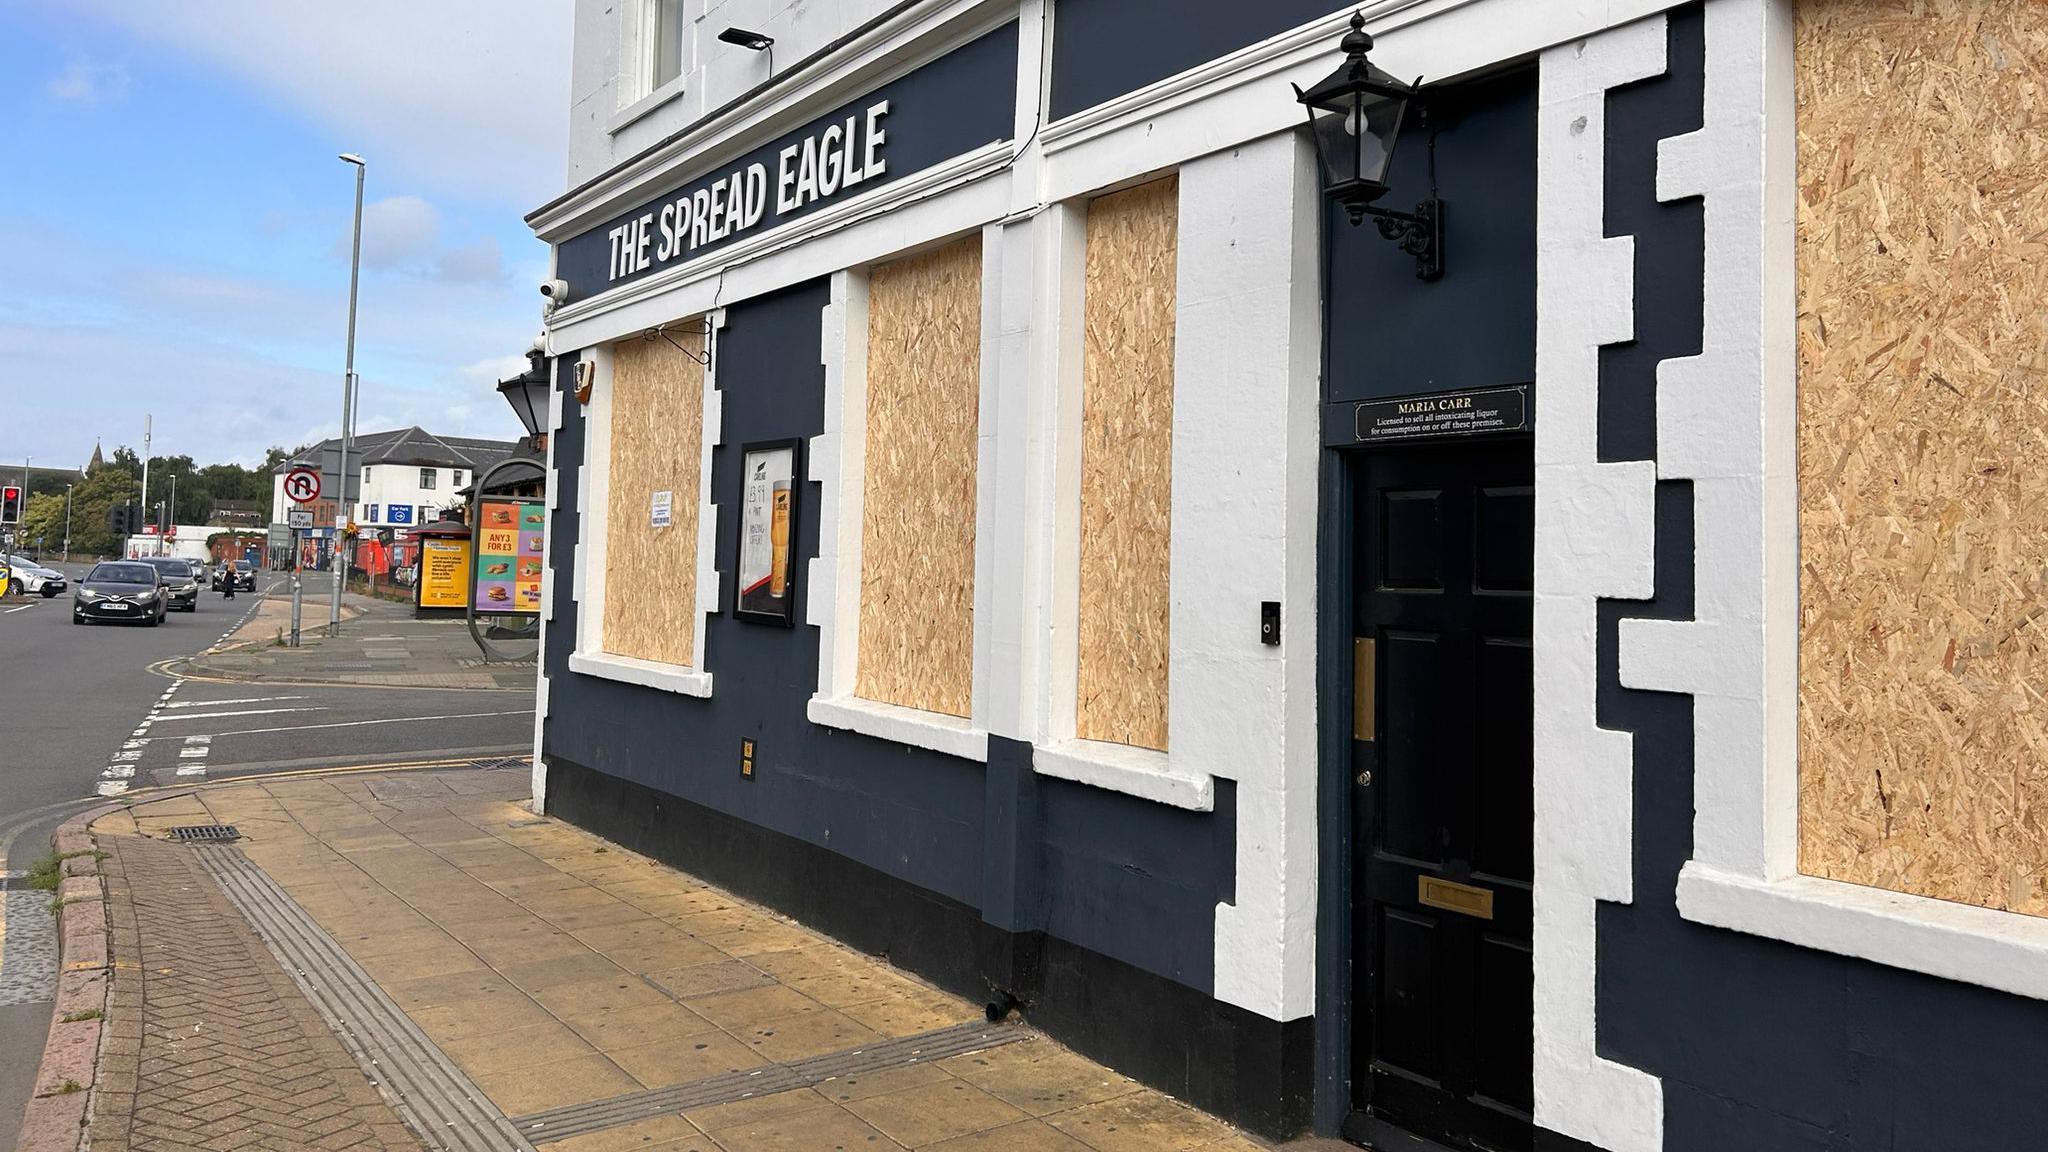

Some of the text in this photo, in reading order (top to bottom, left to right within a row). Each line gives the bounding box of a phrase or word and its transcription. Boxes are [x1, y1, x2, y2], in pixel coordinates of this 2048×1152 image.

[609, 99, 889, 281] THE SPREAD EAGLE
[1398, 397, 1472, 414] MARIA CARR
[1376, 416, 1404, 426] Licensed
[1413, 414, 1424, 424] sell
[1424, 413, 1434, 422] all
[1435, 411, 1475, 421] intoxicating
[1476, 409, 1499, 419] liquor
[1370, 427, 1380, 435] for
[1380, 425, 1421, 435] consumption
[1440, 421, 1451, 430] off
[1452, 420, 1471, 429] these
[1471, 418, 1505, 429] premises.
[489, 534, 505, 542] ANY
[487, 543, 502, 551] FOR
